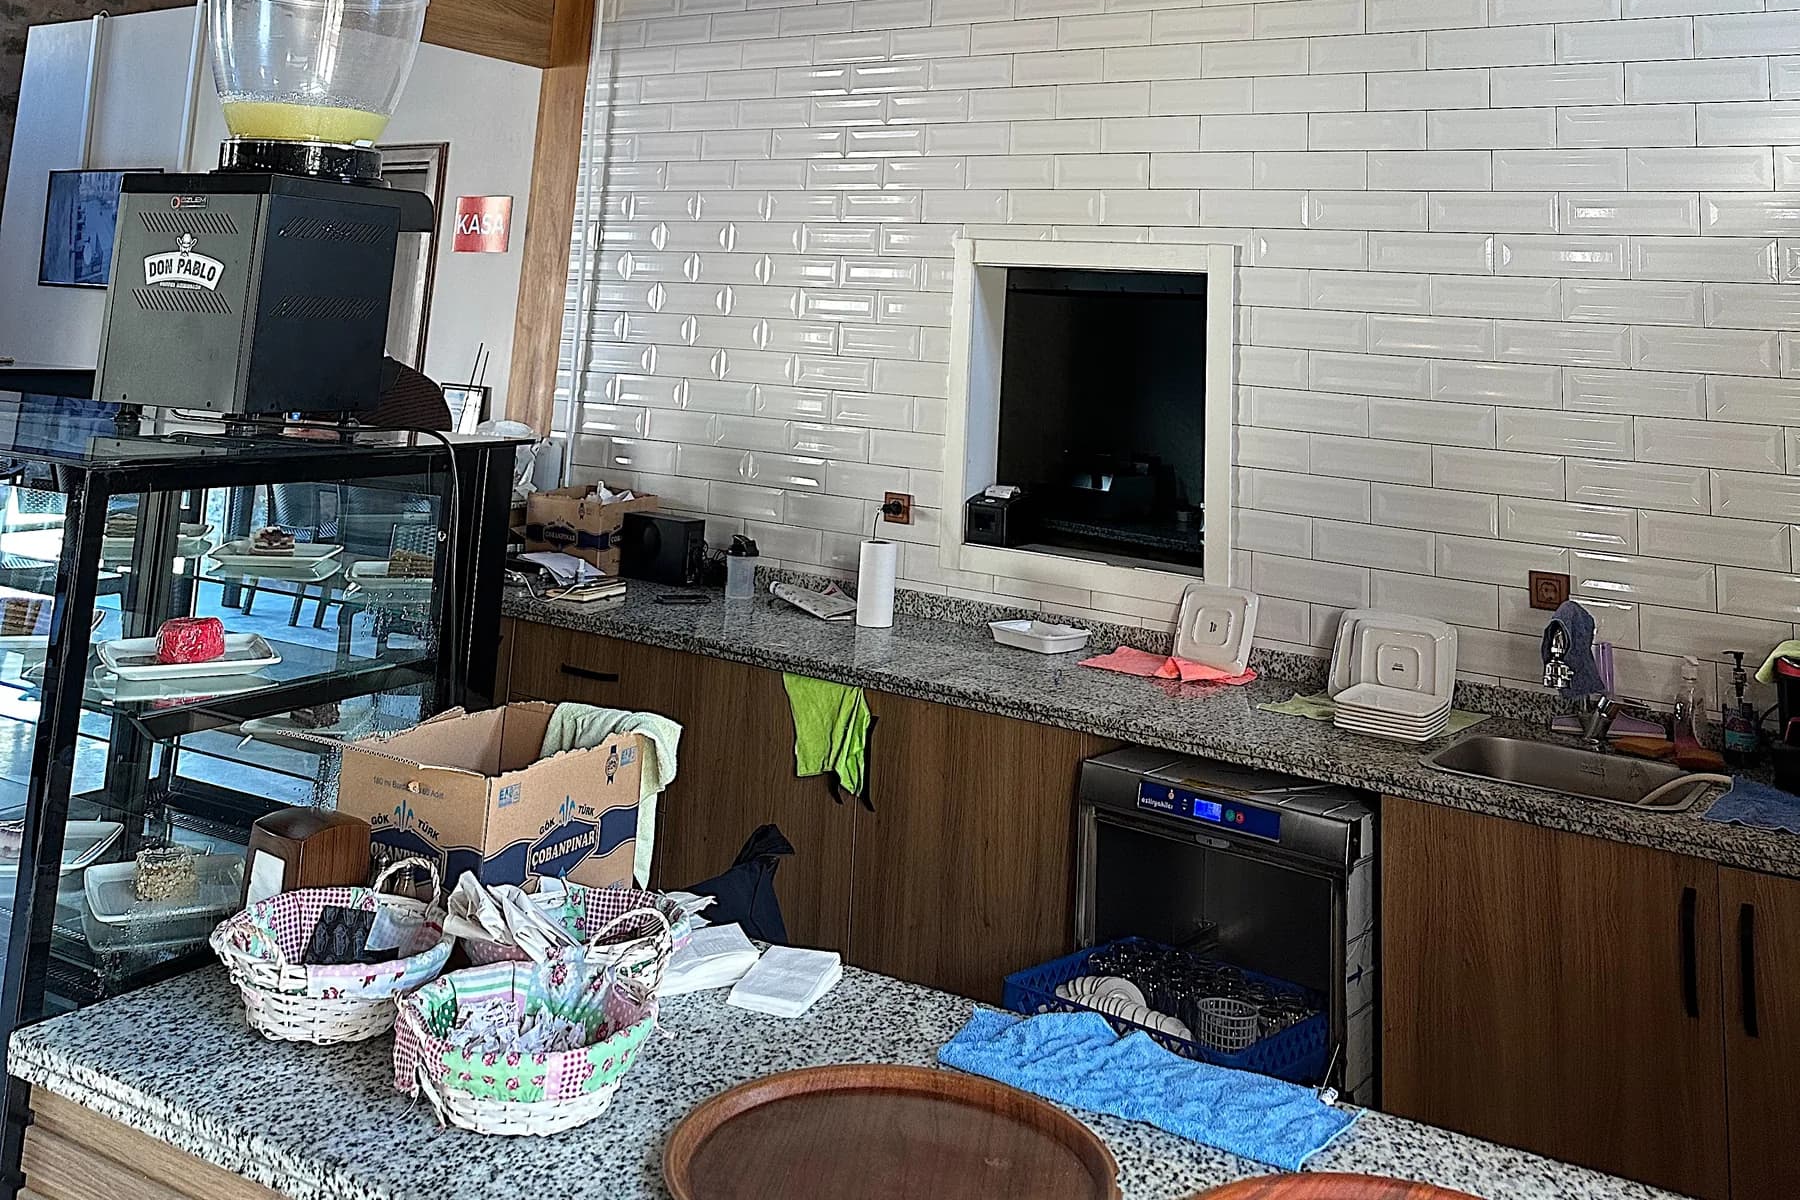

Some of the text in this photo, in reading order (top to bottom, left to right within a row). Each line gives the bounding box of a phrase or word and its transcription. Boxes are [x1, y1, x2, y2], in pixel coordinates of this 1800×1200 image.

[456, 213, 505, 235] KASA
[149, 258, 216, 281] DON PABLO
[371, 812, 441, 841] GÖK TÜRK
[539, 803, 595, 835] GÖK TÜRK
[531, 830, 596, 871] ÇOBANPINAR
